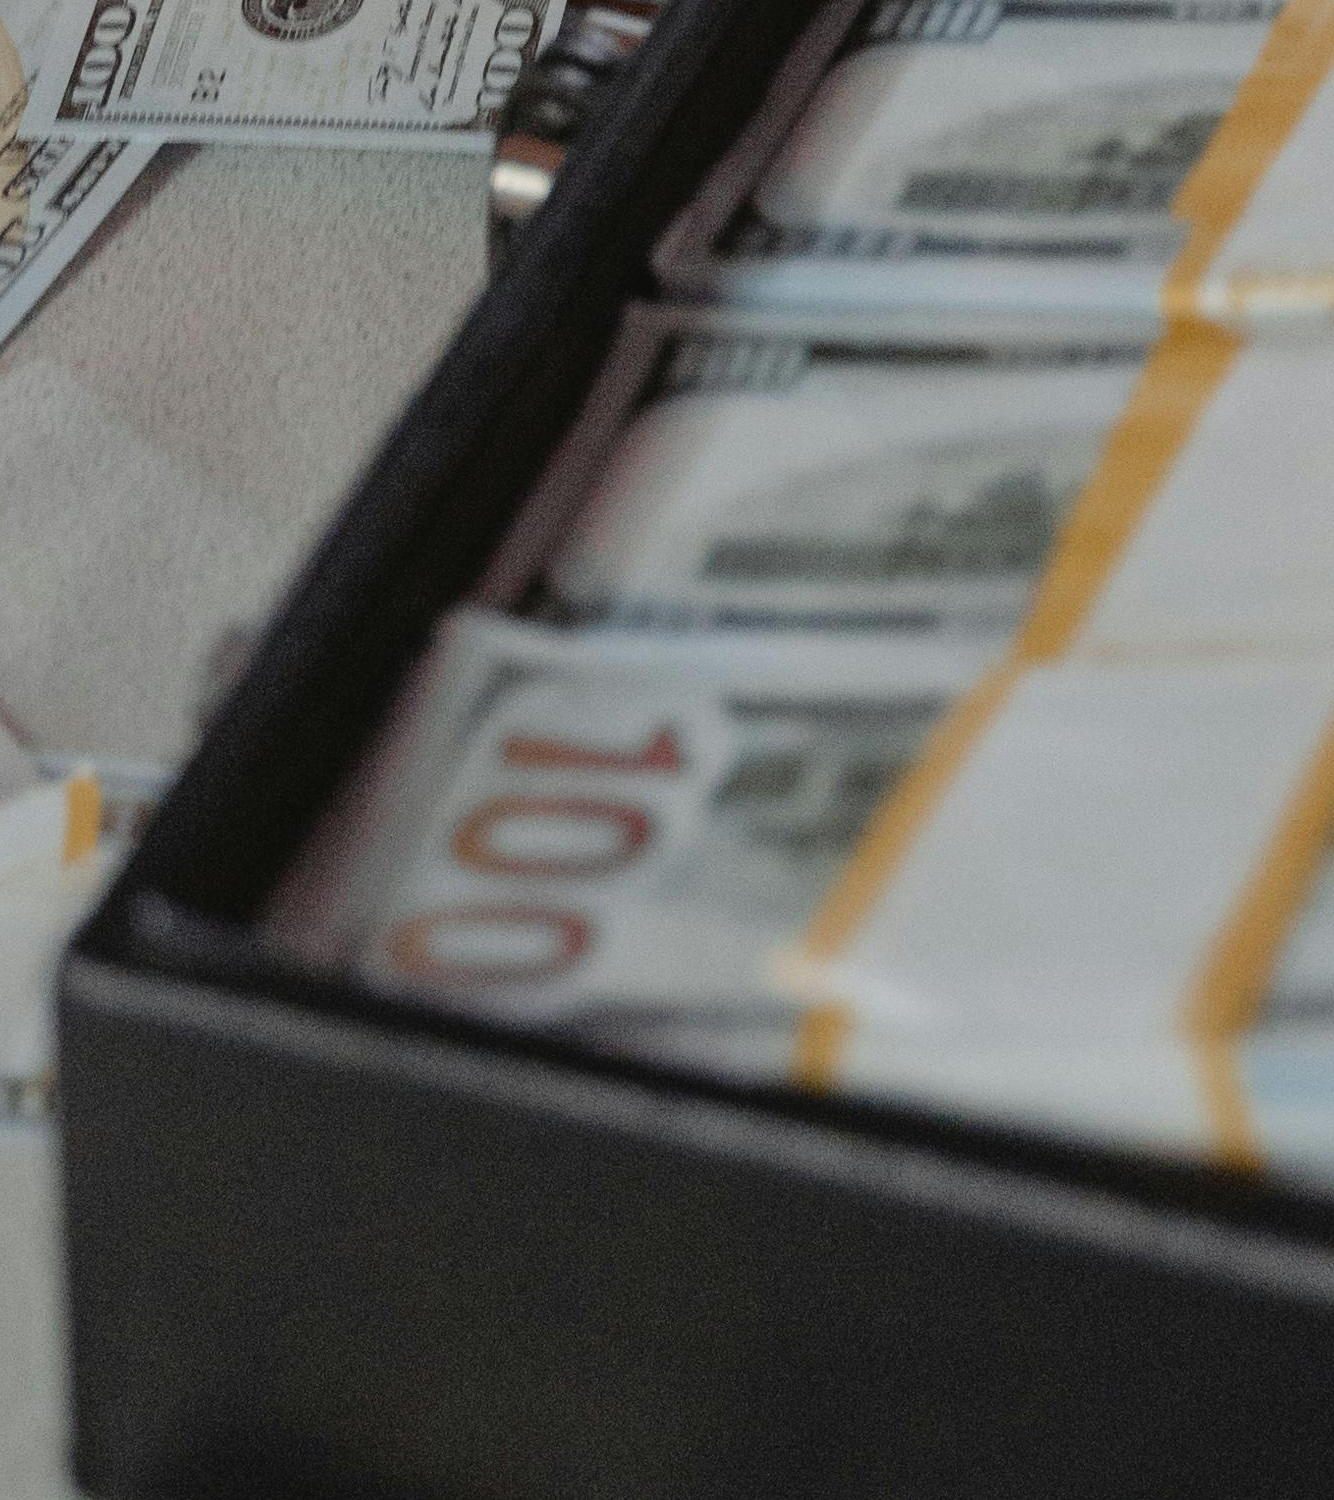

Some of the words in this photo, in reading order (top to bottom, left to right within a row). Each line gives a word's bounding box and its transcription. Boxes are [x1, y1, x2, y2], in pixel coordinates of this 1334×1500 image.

[71, 3, 137, 110] 100
[190, 68, 227, 102] B2
[385, 723, 690, 987] 100
